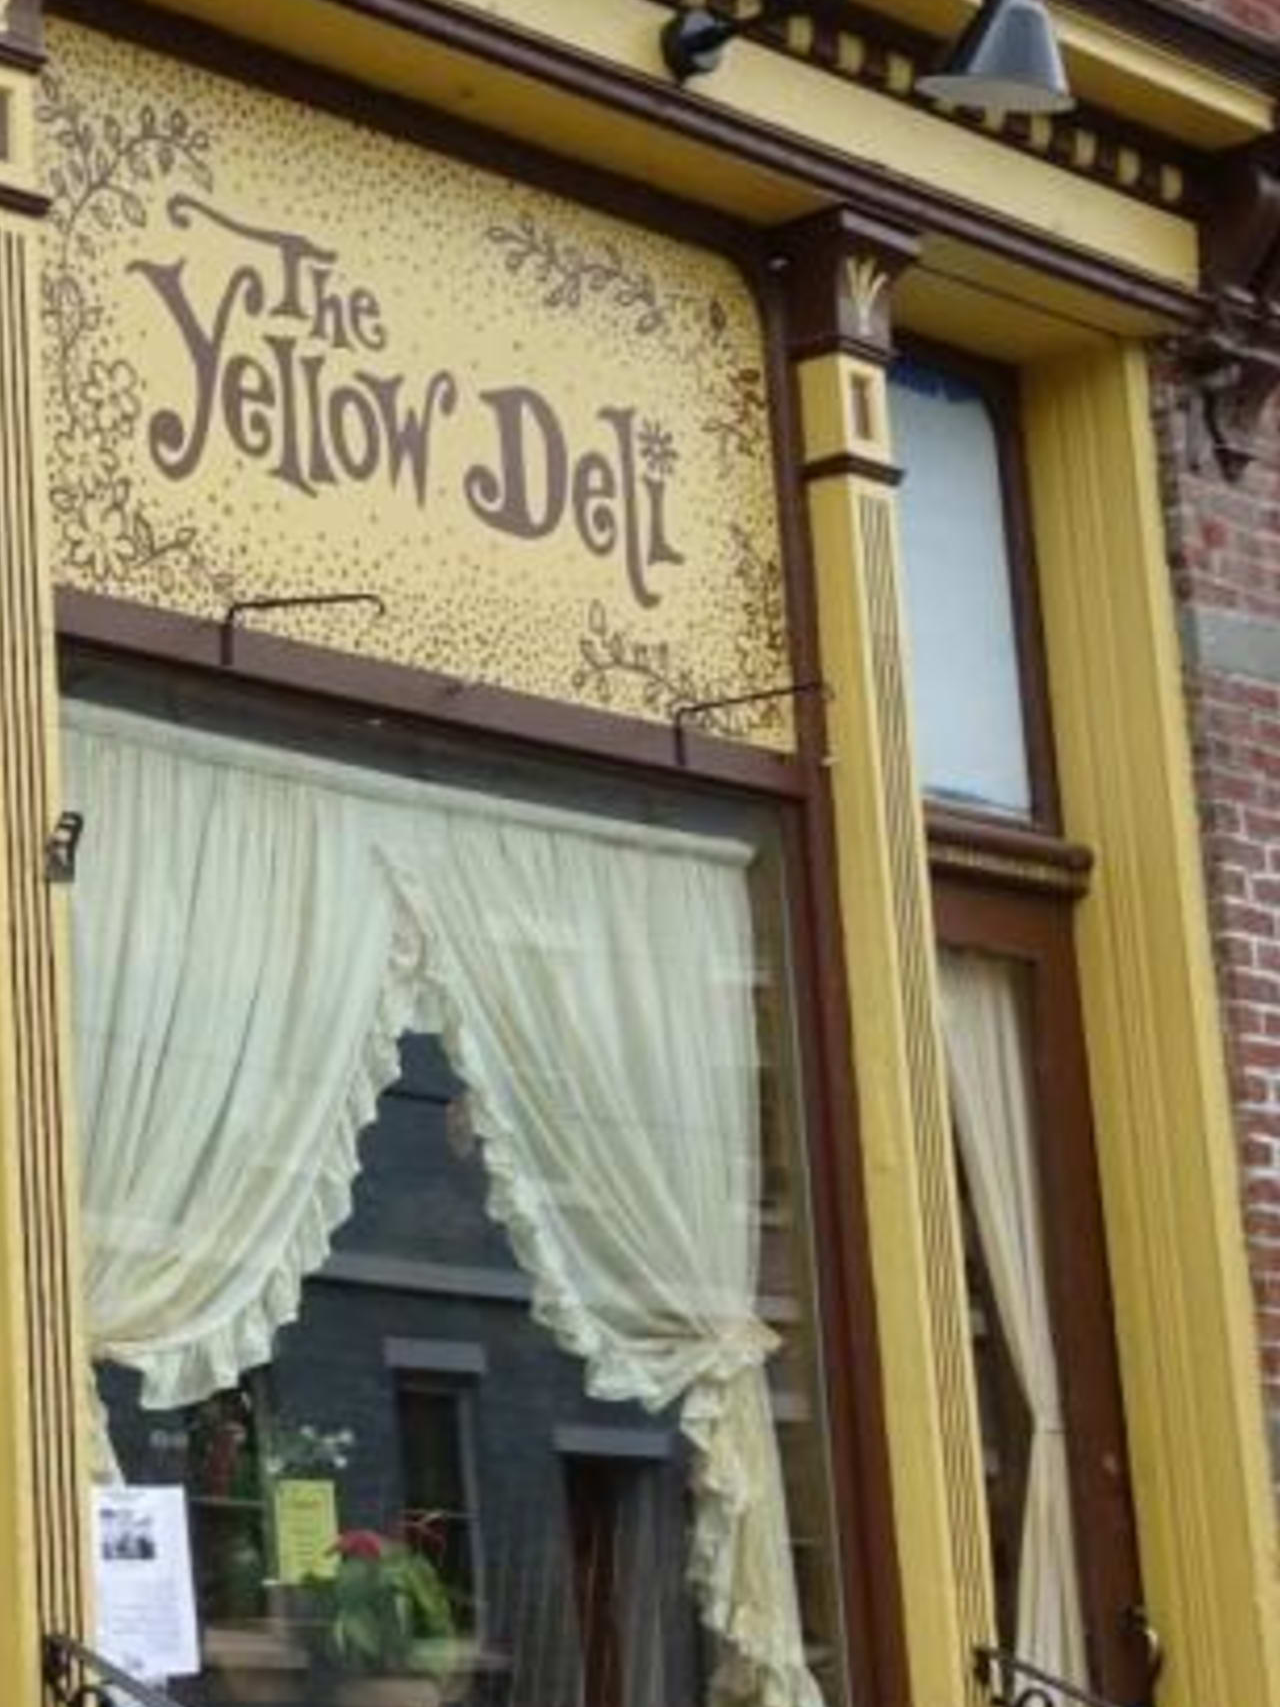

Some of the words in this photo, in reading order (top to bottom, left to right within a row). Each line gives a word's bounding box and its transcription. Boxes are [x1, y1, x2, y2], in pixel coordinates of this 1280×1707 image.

[168, 195, 386, 350] The
[130, 260, 455, 506] Yellow
[464, 388, 684, 606] Deli
